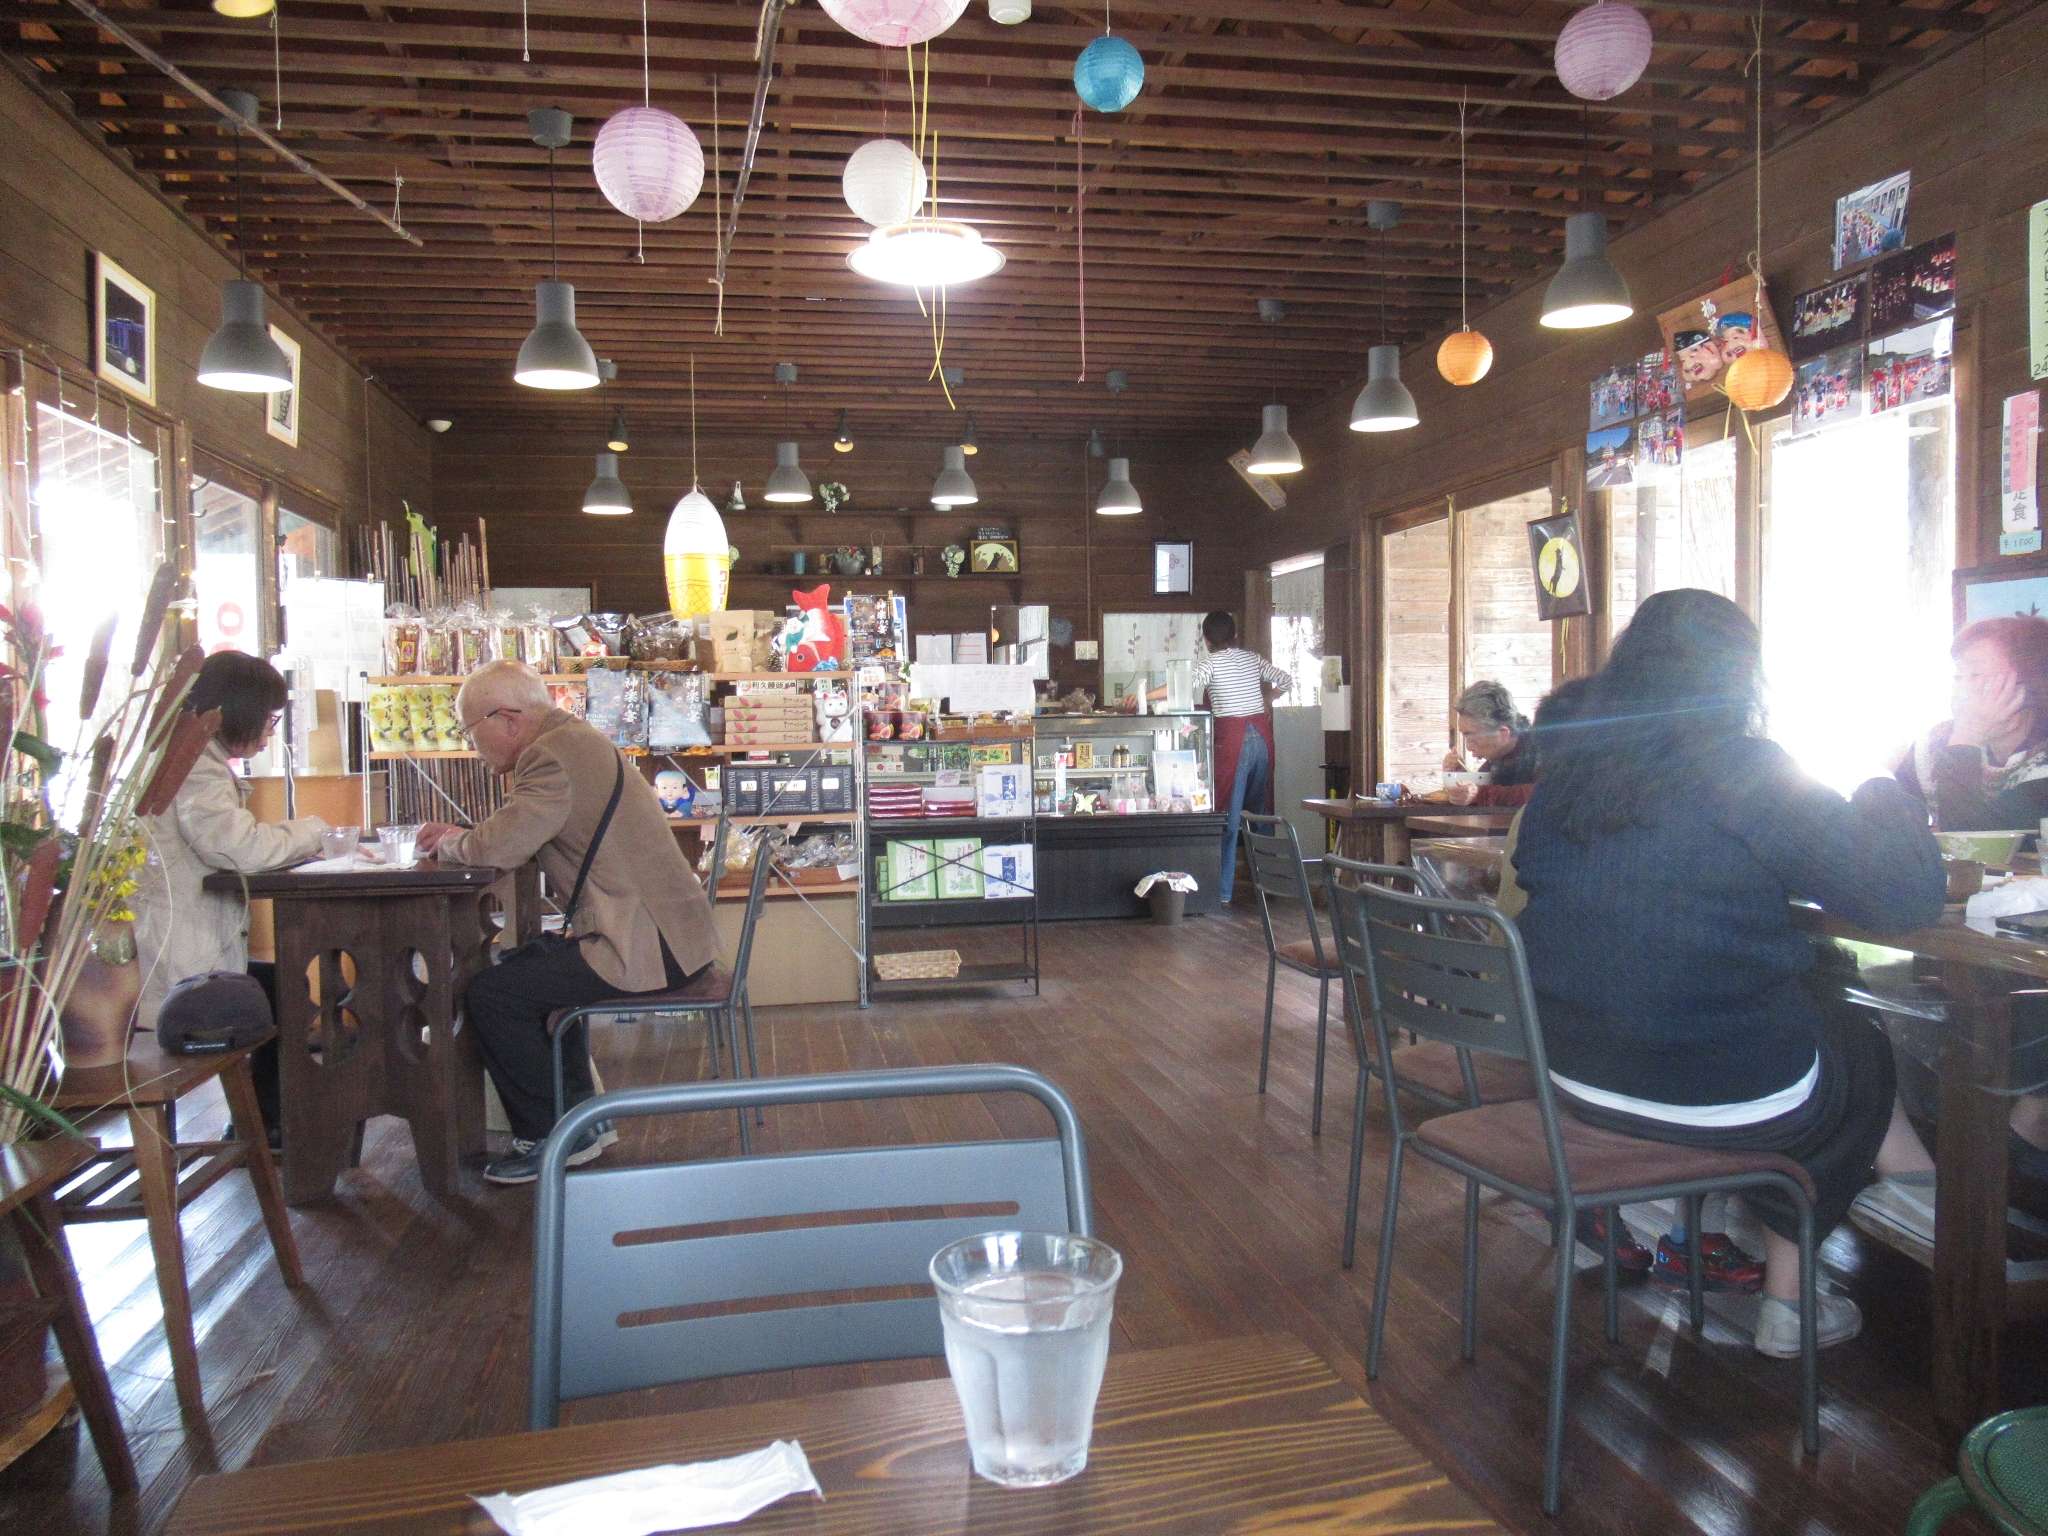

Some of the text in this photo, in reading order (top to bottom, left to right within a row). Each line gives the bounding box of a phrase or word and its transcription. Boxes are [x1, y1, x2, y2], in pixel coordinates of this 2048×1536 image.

[623, 676, 639, 723] 神楽の宴
[684, 677, 702, 723] 神楽の宴
